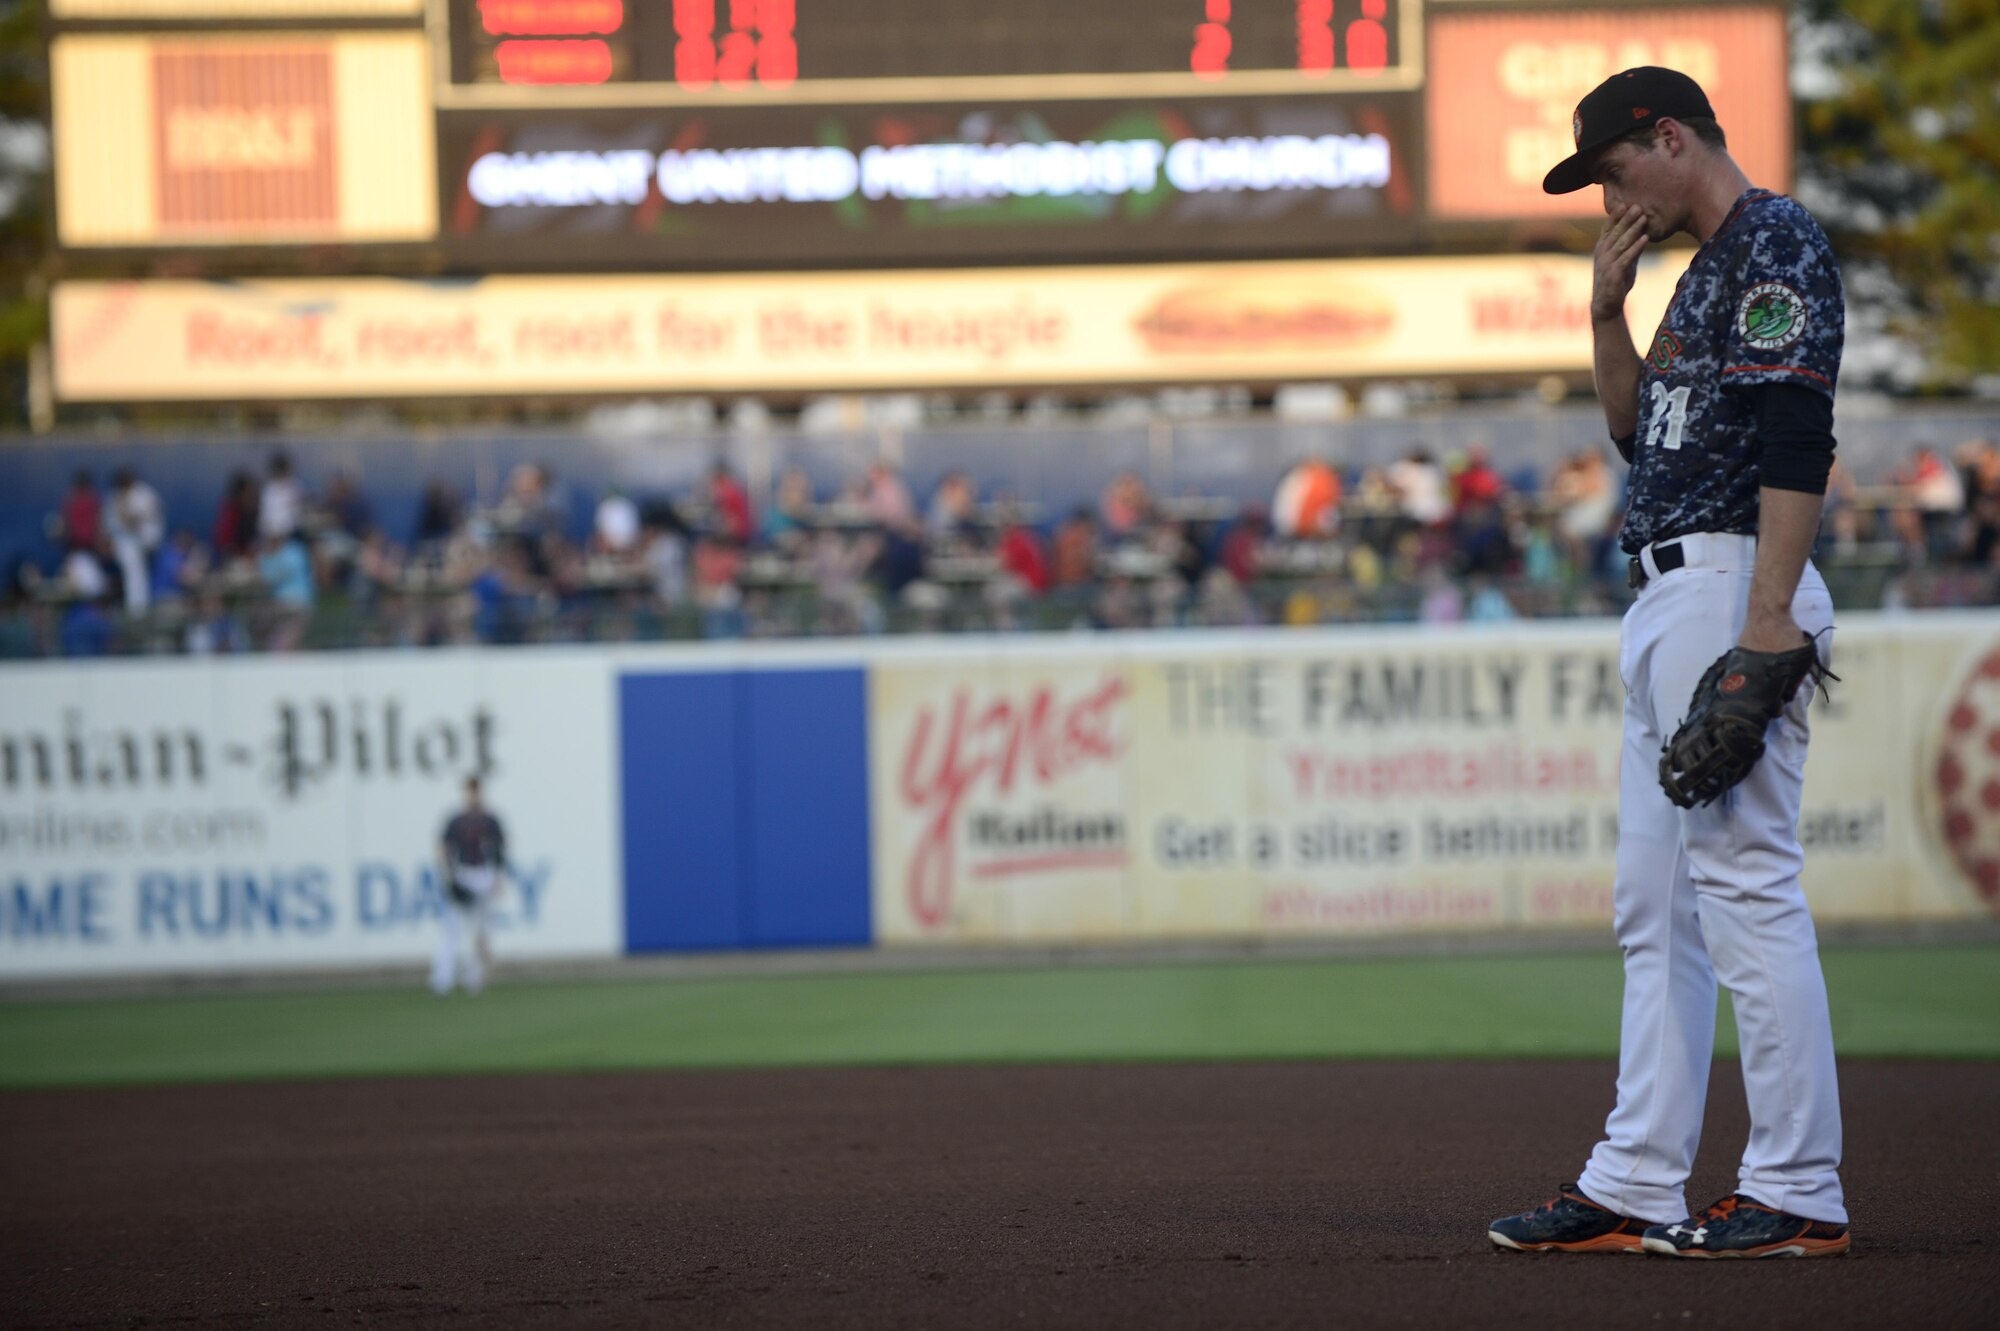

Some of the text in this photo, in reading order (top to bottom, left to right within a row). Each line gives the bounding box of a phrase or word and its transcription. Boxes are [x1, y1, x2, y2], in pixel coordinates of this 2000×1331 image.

[657, 146, 858, 202] UNITED
[860, 140, 1164, 197] METHODIST
[1166, 134, 1391, 191] CHURCH
[756, 297, 853, 356] the
[1645, 380, 1692, 450] 21
[1164, 660, 1283, 737] THE
[1302, 654, 1525, 730] FAMILY
[1157, 815, 1238, 868] Get
[1250, 825, 1281, 868] a
[1294, 809, 1408, 866] slice
[1420, 803, 1591, 860] behind
[133, 863, 335, 942] RUNS
[356, 858, 554, 932] DAY
